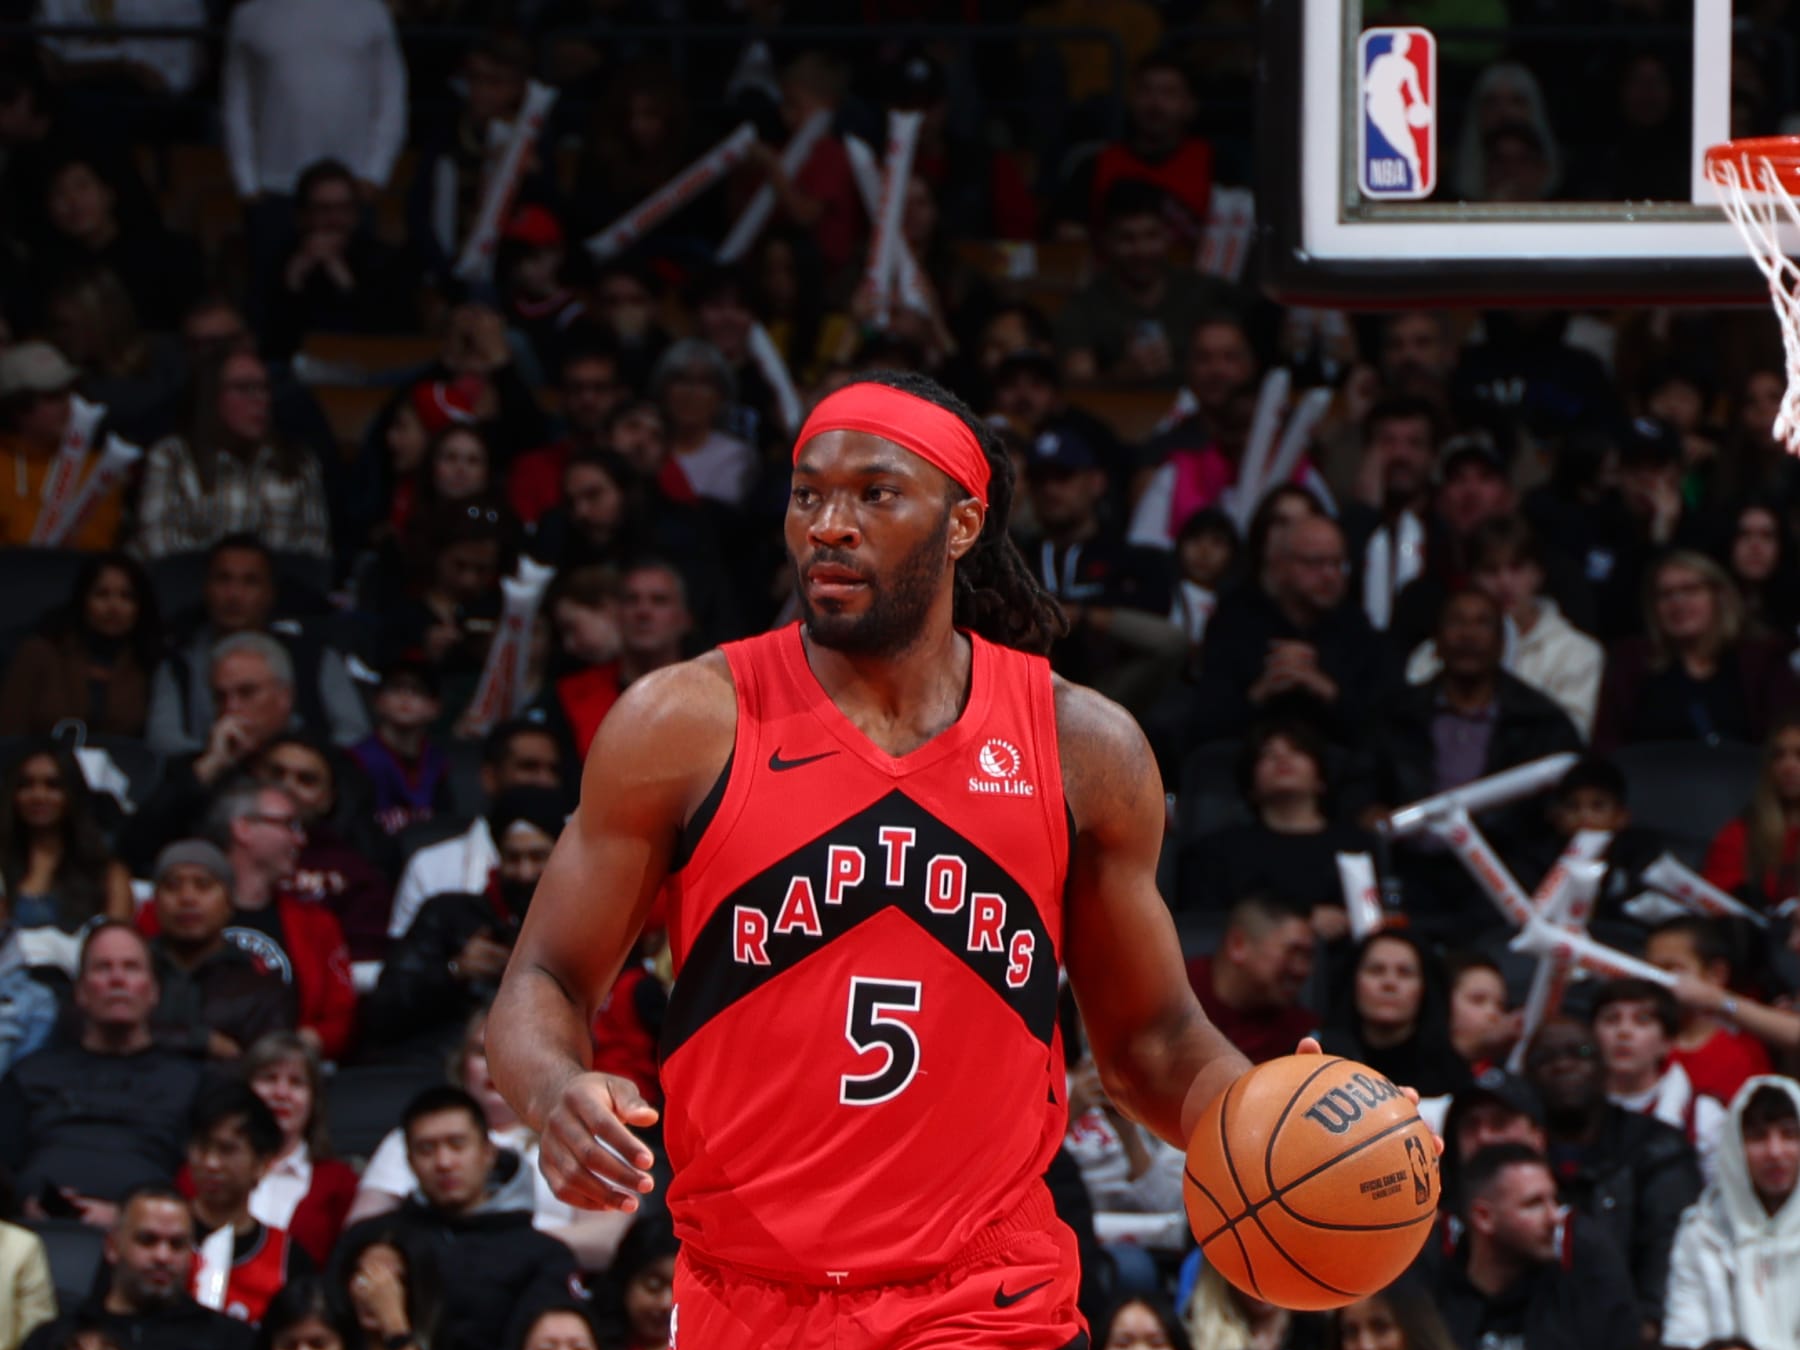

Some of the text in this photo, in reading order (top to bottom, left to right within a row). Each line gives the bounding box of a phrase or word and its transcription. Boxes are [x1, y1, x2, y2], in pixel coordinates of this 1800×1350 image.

[1369, 157, 1408, 187] NBA
[968, 776, 1034, 796] Sun Life
[733, 825, 1036, 988] RAPTORS
[839, 975, 922, 1106] 5
[1303, 1072, 1404, 1135] Wils
